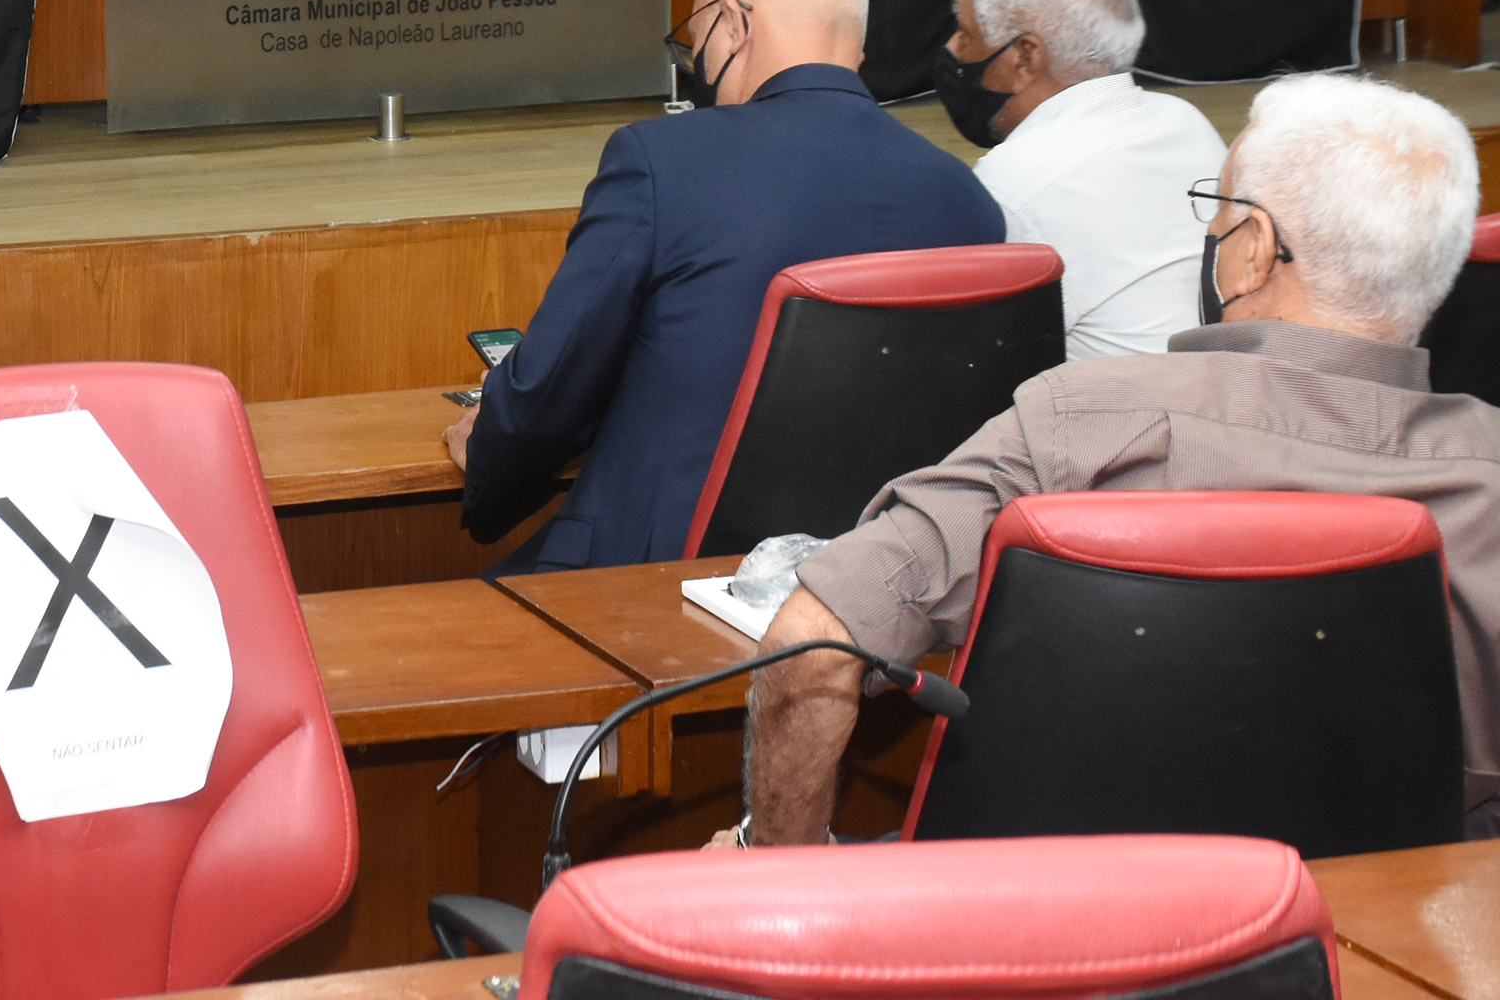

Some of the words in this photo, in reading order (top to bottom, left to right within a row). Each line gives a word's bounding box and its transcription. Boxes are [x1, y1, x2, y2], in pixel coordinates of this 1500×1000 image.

[226, 4, 301, 25] Câmara
[261, 32, 308, 52] Casa
[320, 29, 342, 48] de
[349, 24, 434, 50] Napoleão
[441, 20, 525, 41] Laureano
[52, 742, 83, 762] NÃO
[86, 733, 144, 755] SENTAR
